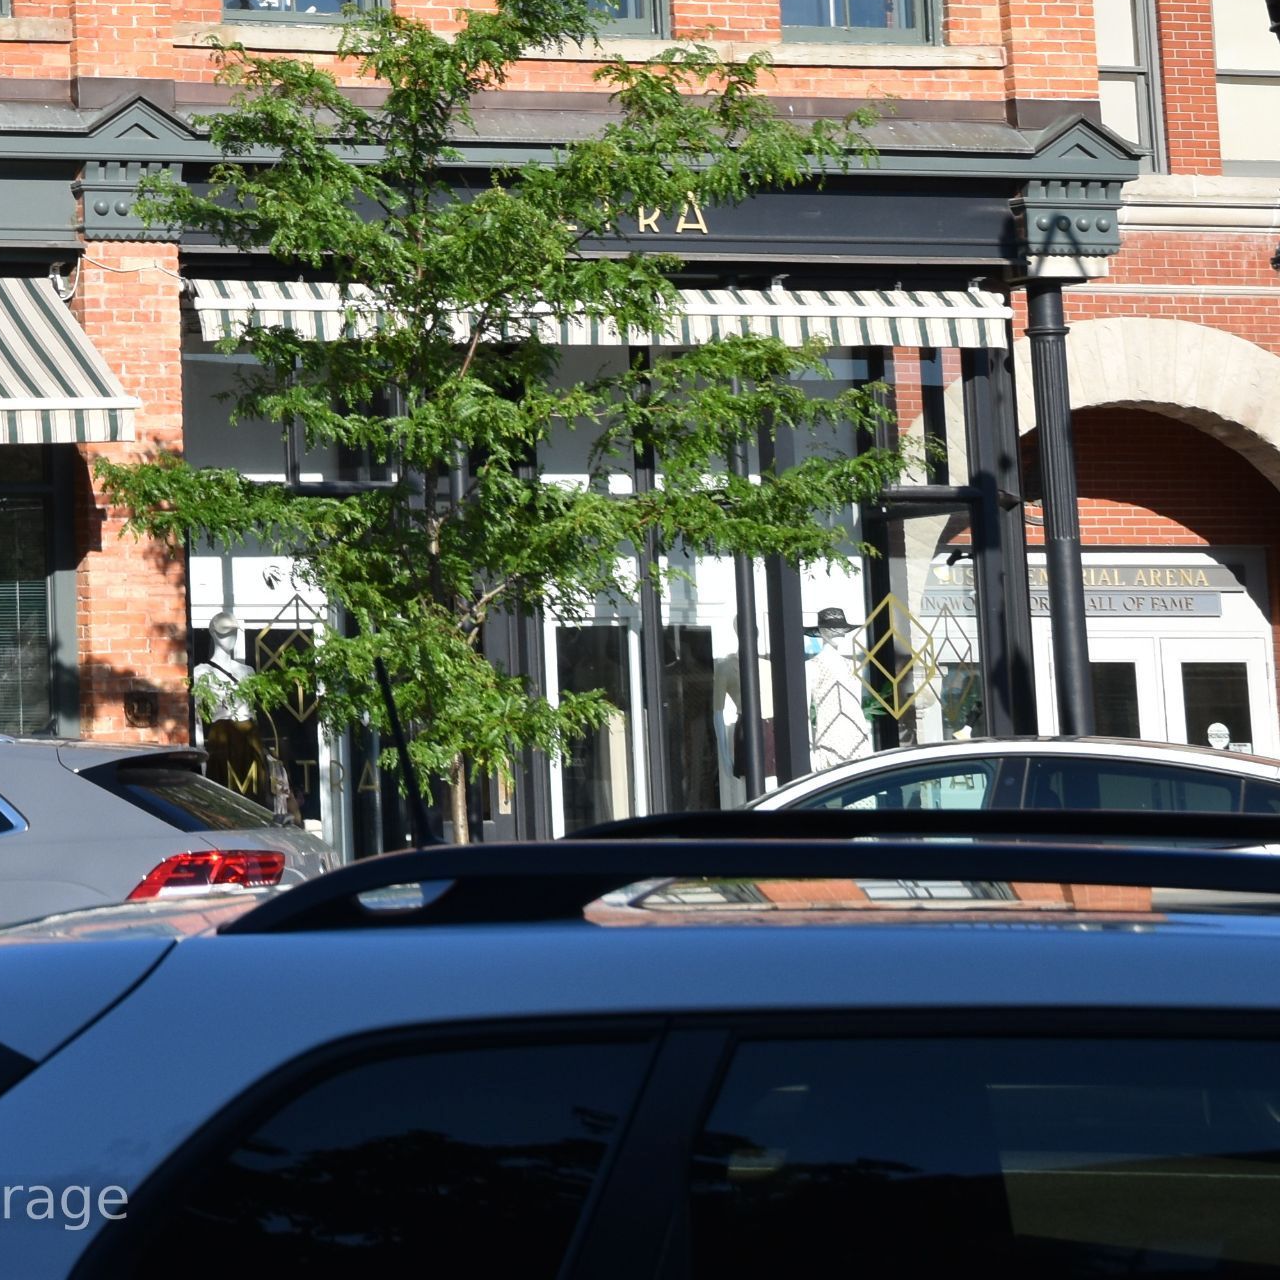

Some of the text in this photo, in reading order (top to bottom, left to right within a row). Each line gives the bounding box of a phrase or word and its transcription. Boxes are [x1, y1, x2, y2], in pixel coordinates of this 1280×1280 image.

[1134, 569, 1210, 587] ARENA
[1088, 596, 1194, 611] ALL OF FAME
